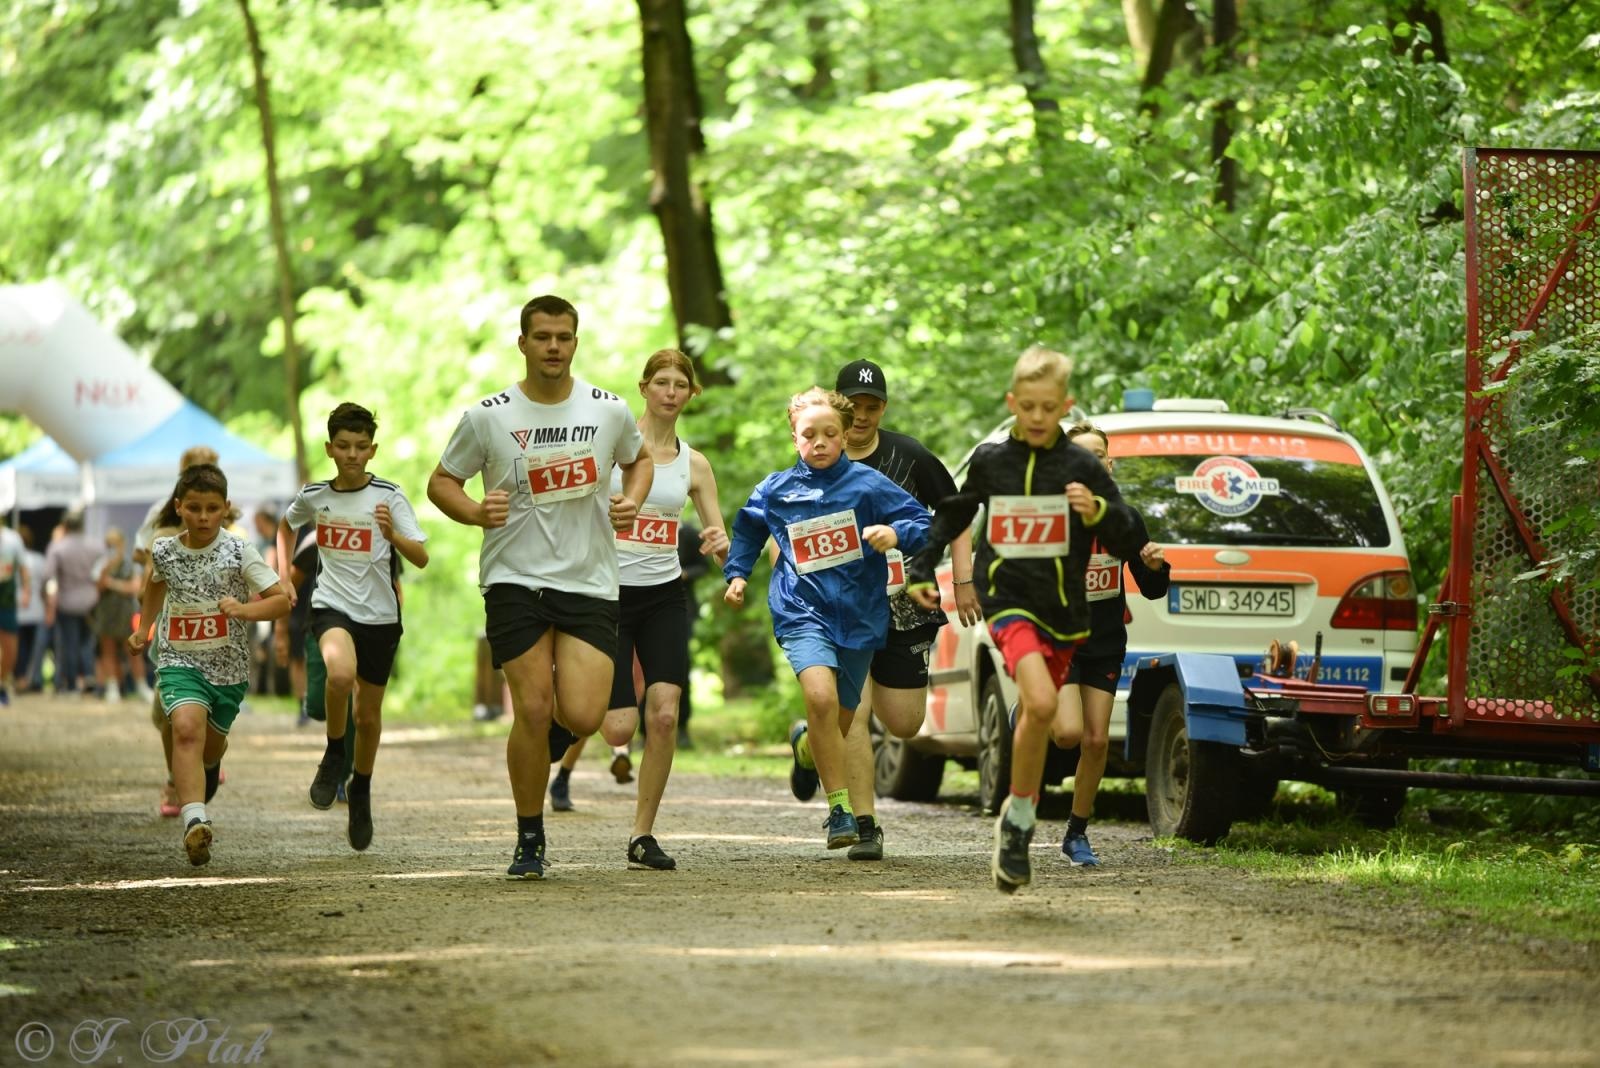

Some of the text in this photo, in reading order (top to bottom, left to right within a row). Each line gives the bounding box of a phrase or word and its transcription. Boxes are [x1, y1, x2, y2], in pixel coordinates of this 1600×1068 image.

[533, 425, 599, 445] MMA CITY
[1137, 433, 1309, 456] AMBULANS
[540, 460, 588, 490] 175
[1177, 479, 1278, 492] FIRE MED
[324, 527, 363, 550] 176
[628, 519, 669, 543] 164
[1001, 516, 1055, 543] 177
[803, 530, 849, 560] 183
[1181, 589, 1291, 612] SWD 34945
[178, 617, 218, 640] 178
[1345, 667, 1370, 682] 112
